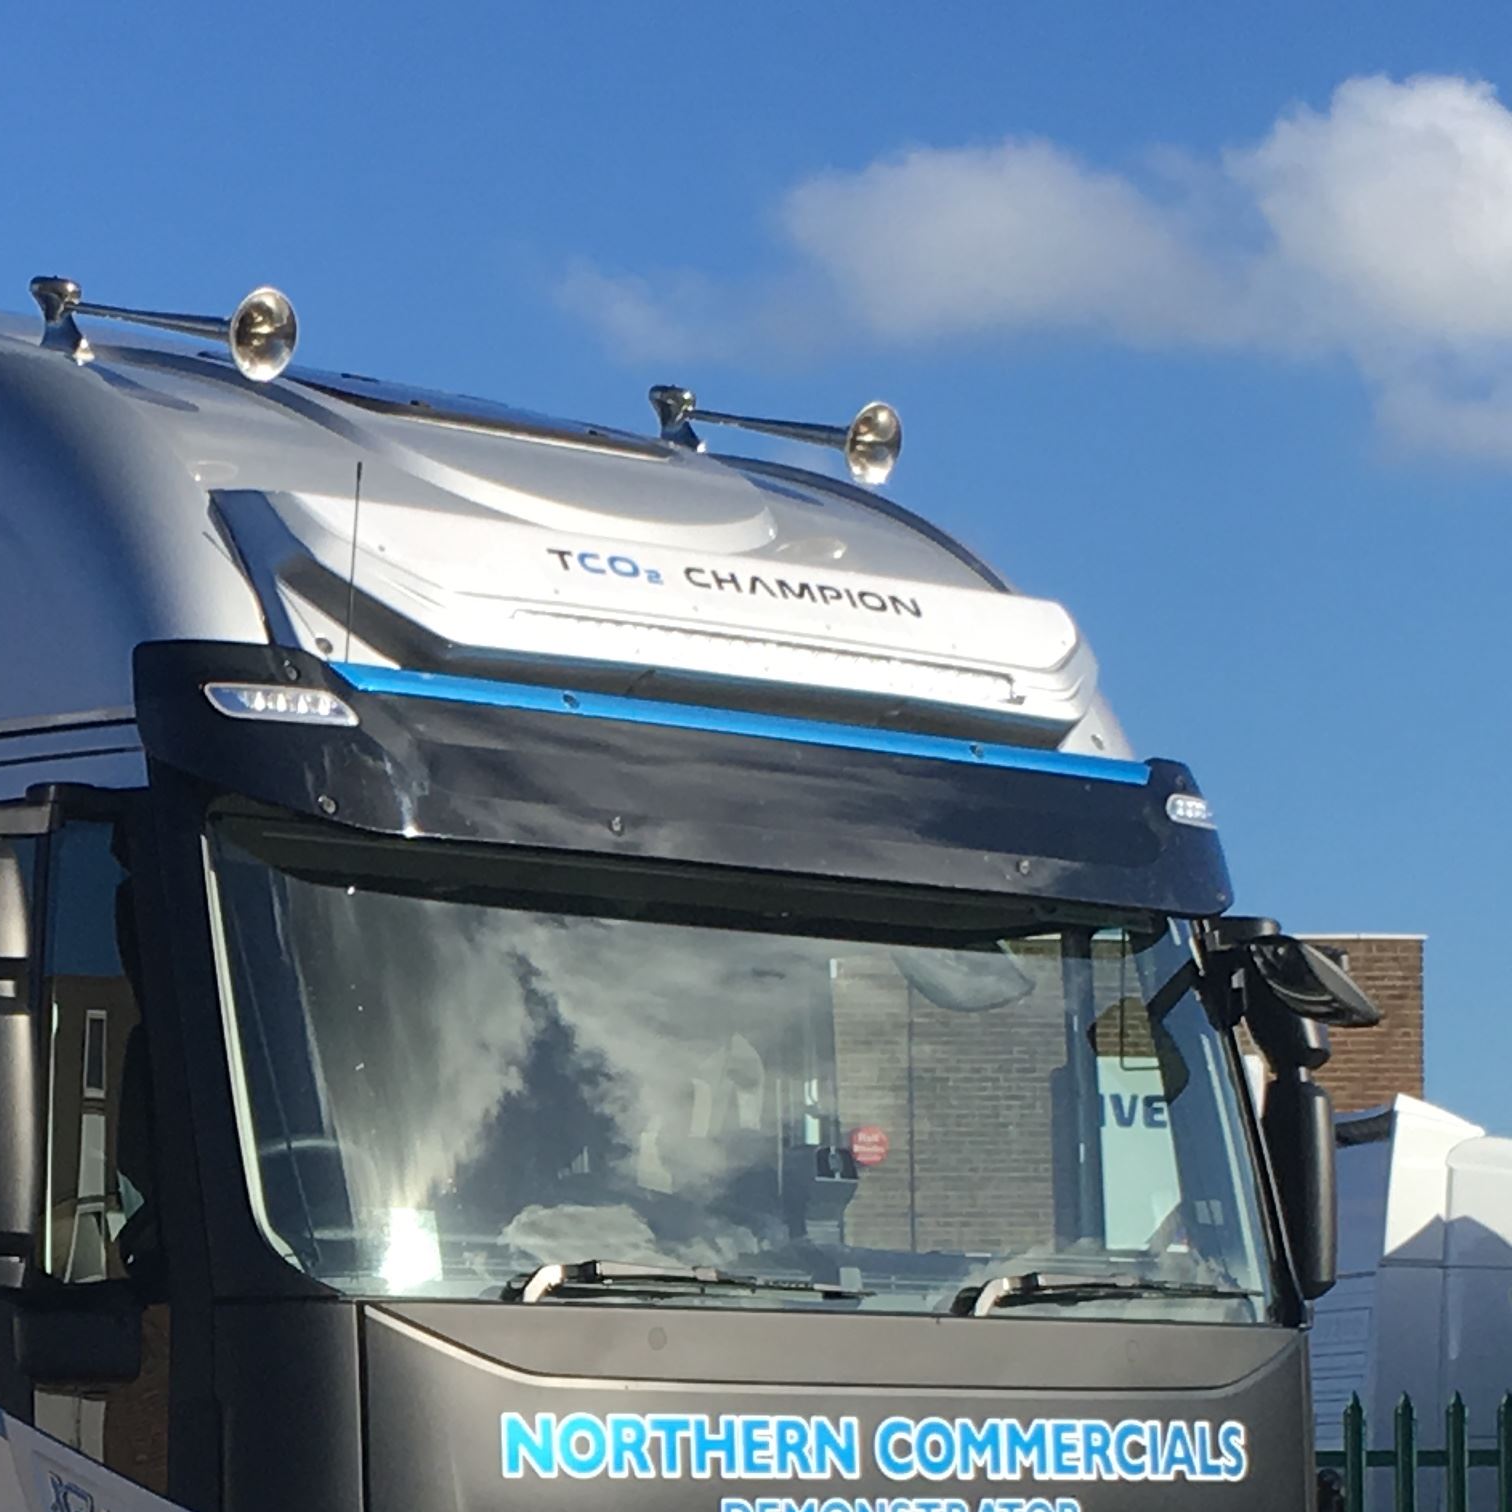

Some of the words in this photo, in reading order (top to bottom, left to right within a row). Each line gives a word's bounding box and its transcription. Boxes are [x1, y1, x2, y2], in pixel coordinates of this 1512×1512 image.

[683, 566, 923, 619] CHAMPION
[500, 1412, 861, 1480] NORTHERN
[874, 1416, 1248, 1482] COMMERCIALS
